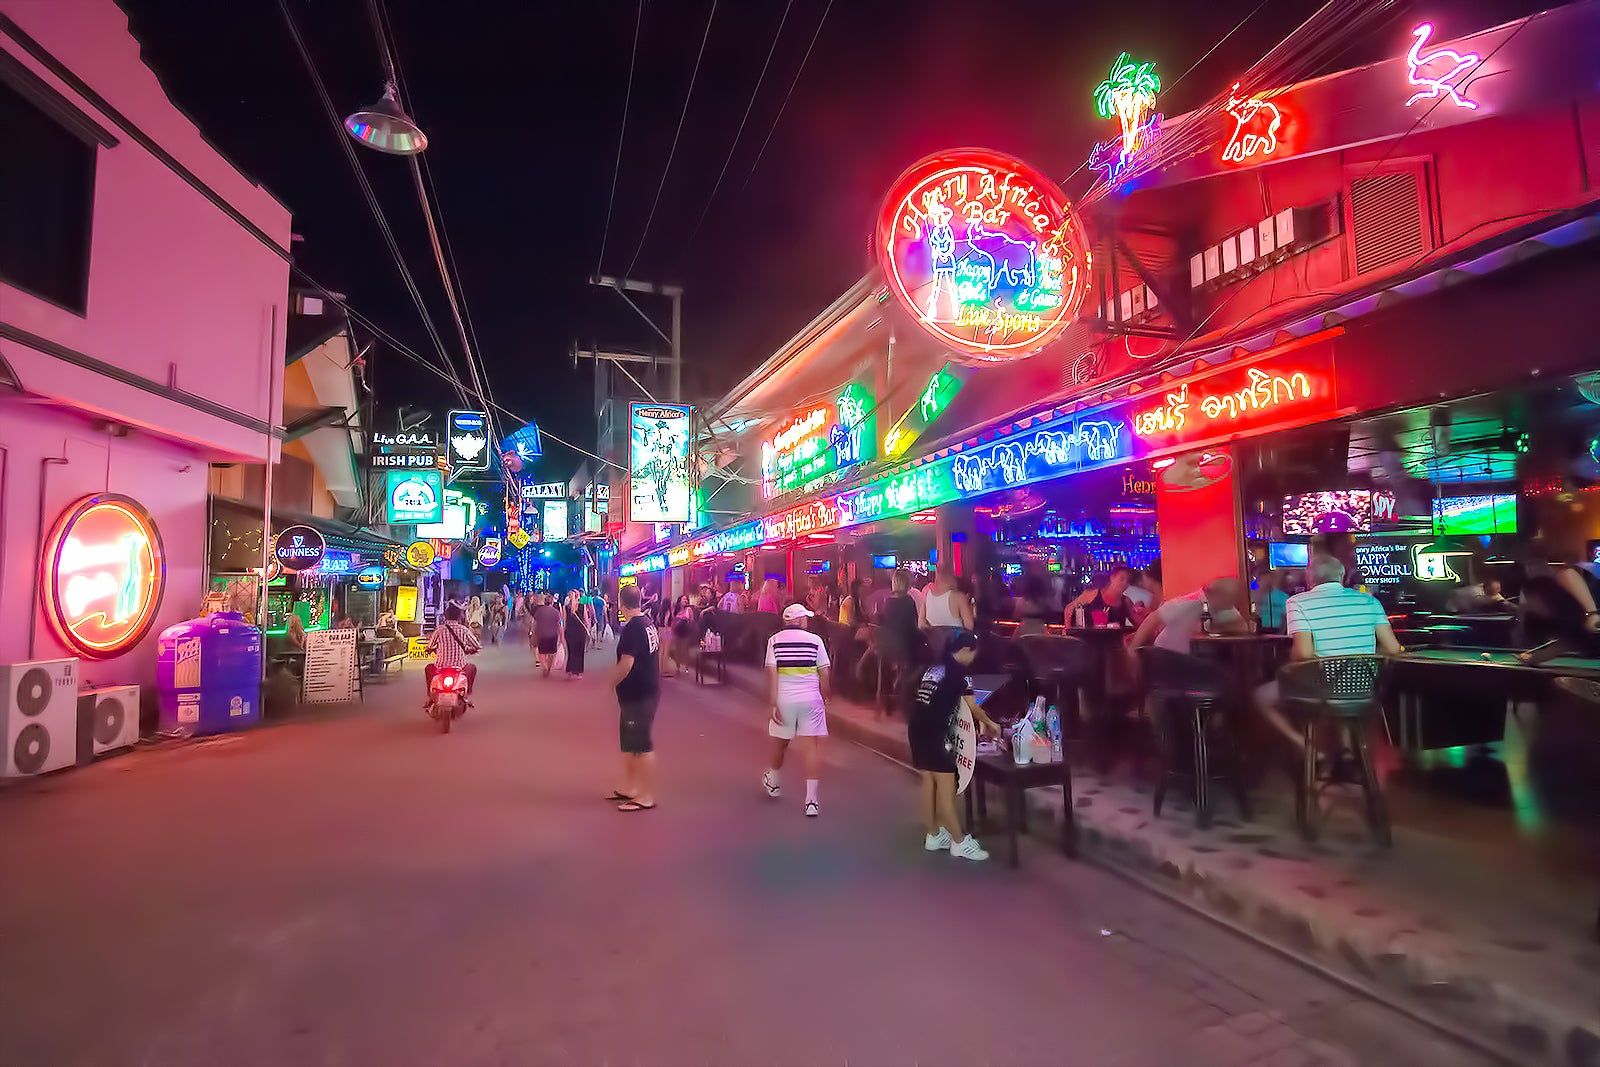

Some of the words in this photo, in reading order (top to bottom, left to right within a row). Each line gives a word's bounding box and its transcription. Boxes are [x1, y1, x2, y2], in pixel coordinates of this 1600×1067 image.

[962, 200, 1012, 226] Bar
[372, 456, 405, 466] IRISH
[408, 455, 434, 466] PUB
[1120, 474, 1157, 496] Henr
[854, 490, 884, 517] Happy
[815, 501, 838, 528] Bar
[277, 547, 321, 558] GUINNESS
[1370, 545, 1395, 553] Africa's
[321, 558, 350, 571] BAR
[1357, 565, 1413, 576] OWGIRL
[1380, 576, 1400, 584] SHOTS
